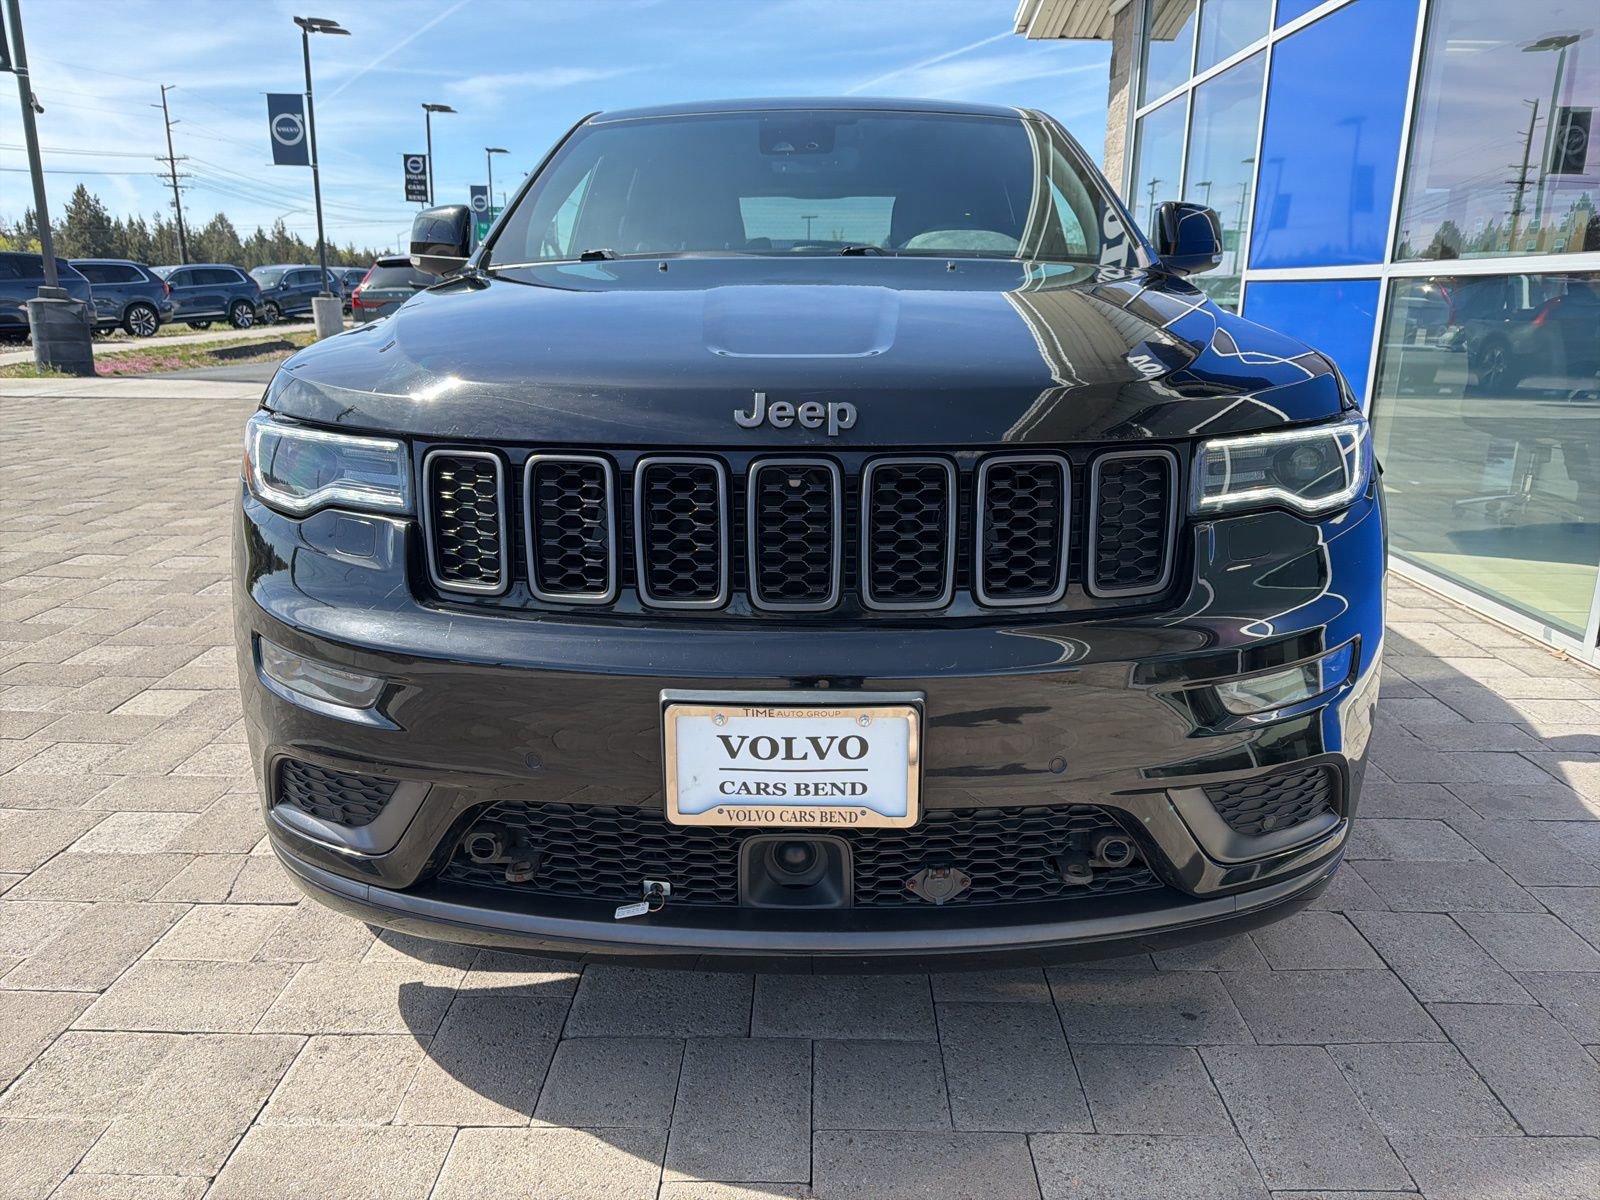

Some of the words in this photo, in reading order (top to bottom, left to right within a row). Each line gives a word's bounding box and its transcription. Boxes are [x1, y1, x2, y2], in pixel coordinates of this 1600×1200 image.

[734, 392, 857, 436] Jeep
[743, 708, 775, 718] TIME
[776, 710, 803, 718] AUTO
[806, 710, 841, 718] GROUP
[716, 734, 869, 761] VOLVO
[718, 780, 787, 796] CARS
[793, 782, 868, 797] BEND
[726, 809, 776, 823] VOLVO
[779, 810, 816, 823] CARS
[819, 810, 858, 824] BEND
